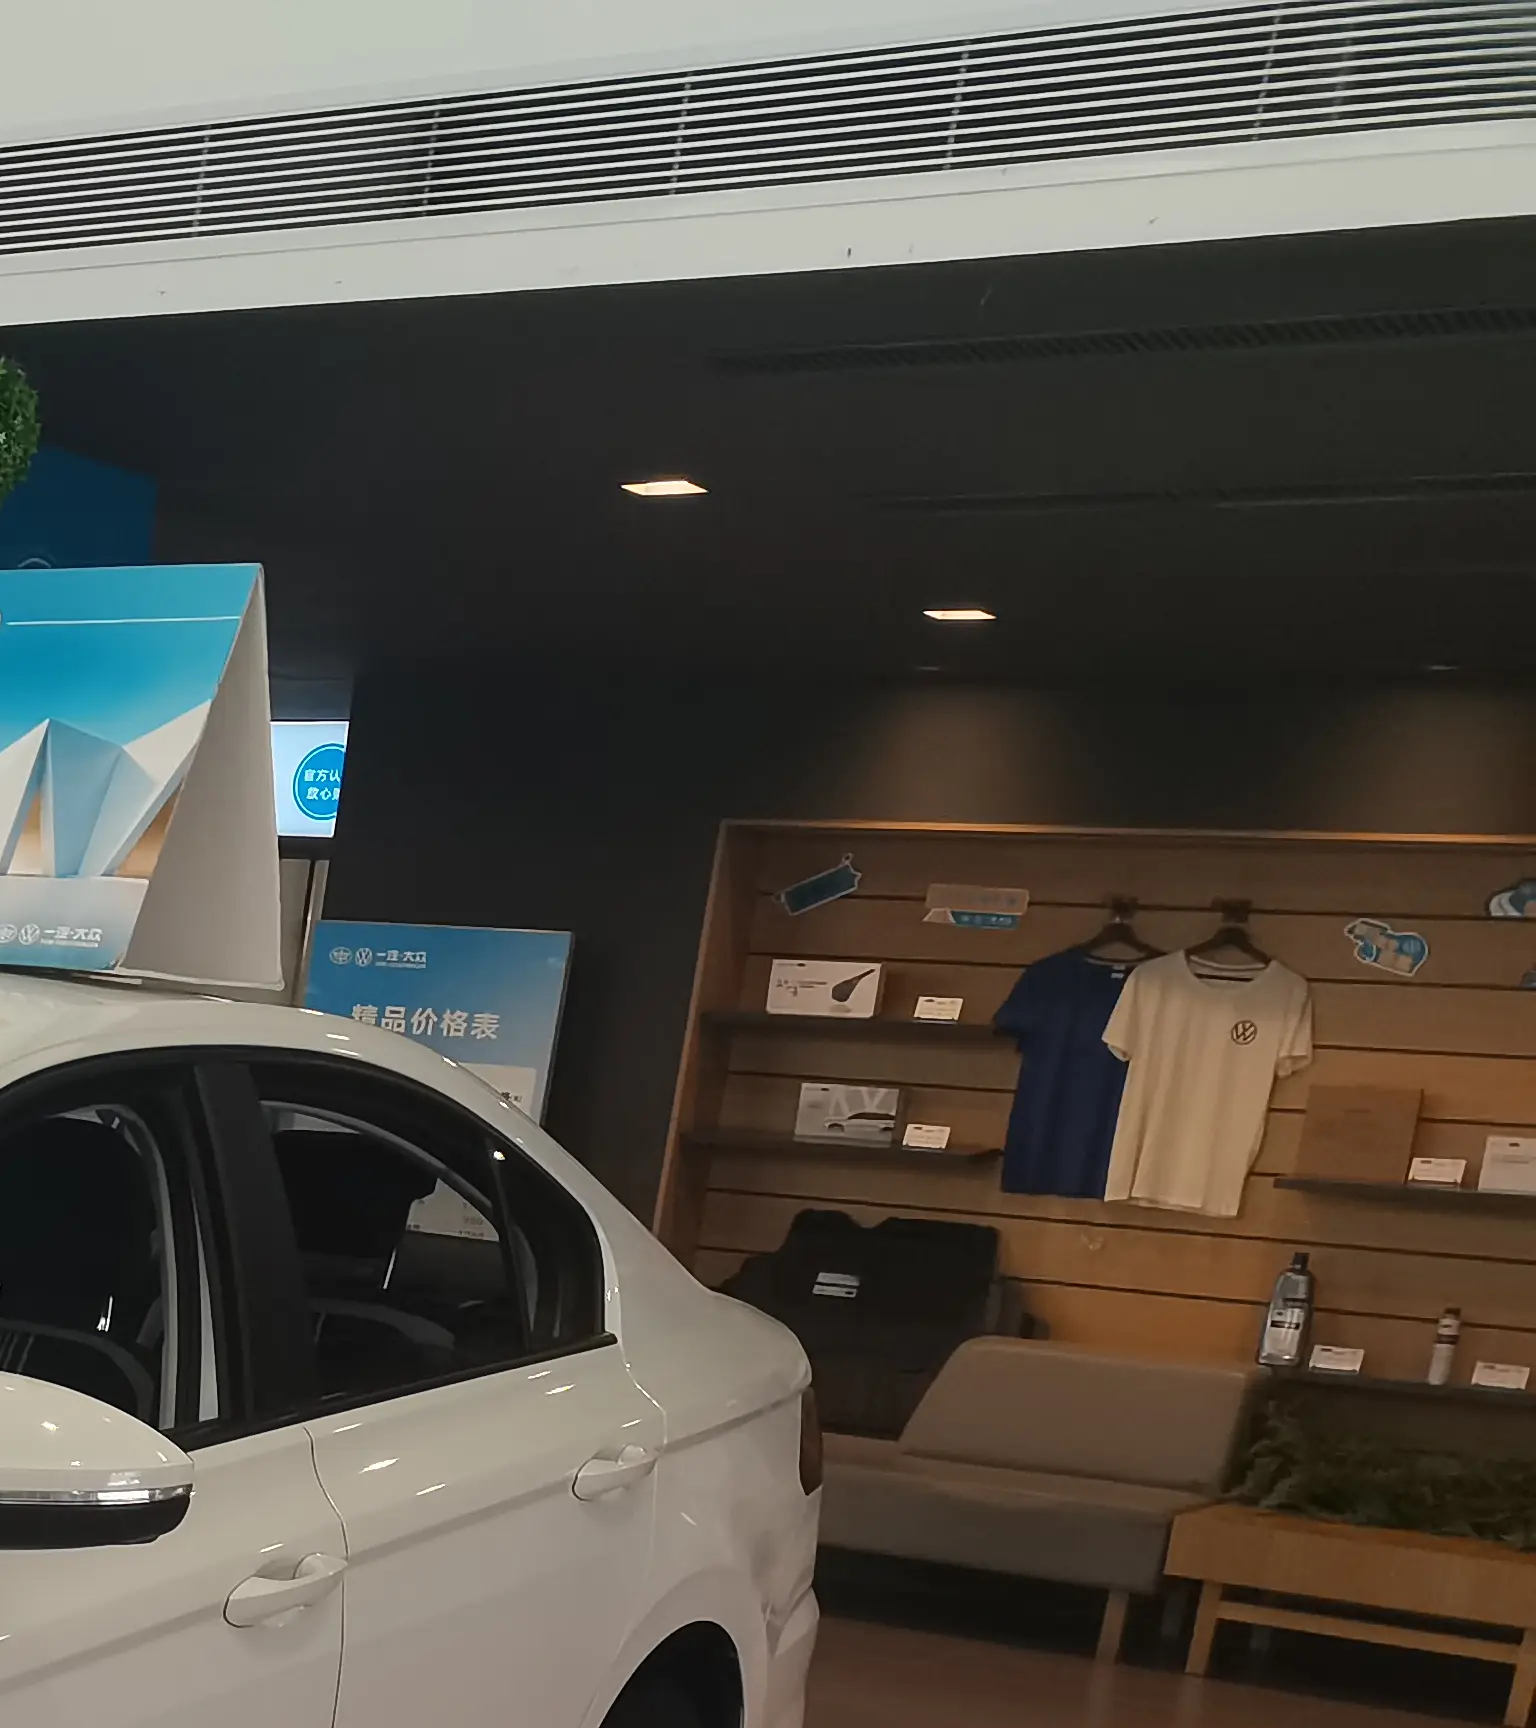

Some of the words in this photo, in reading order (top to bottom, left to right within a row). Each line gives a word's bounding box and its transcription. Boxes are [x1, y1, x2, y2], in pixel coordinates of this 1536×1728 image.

[352, 1004, 500, 1040] 精品价格表
